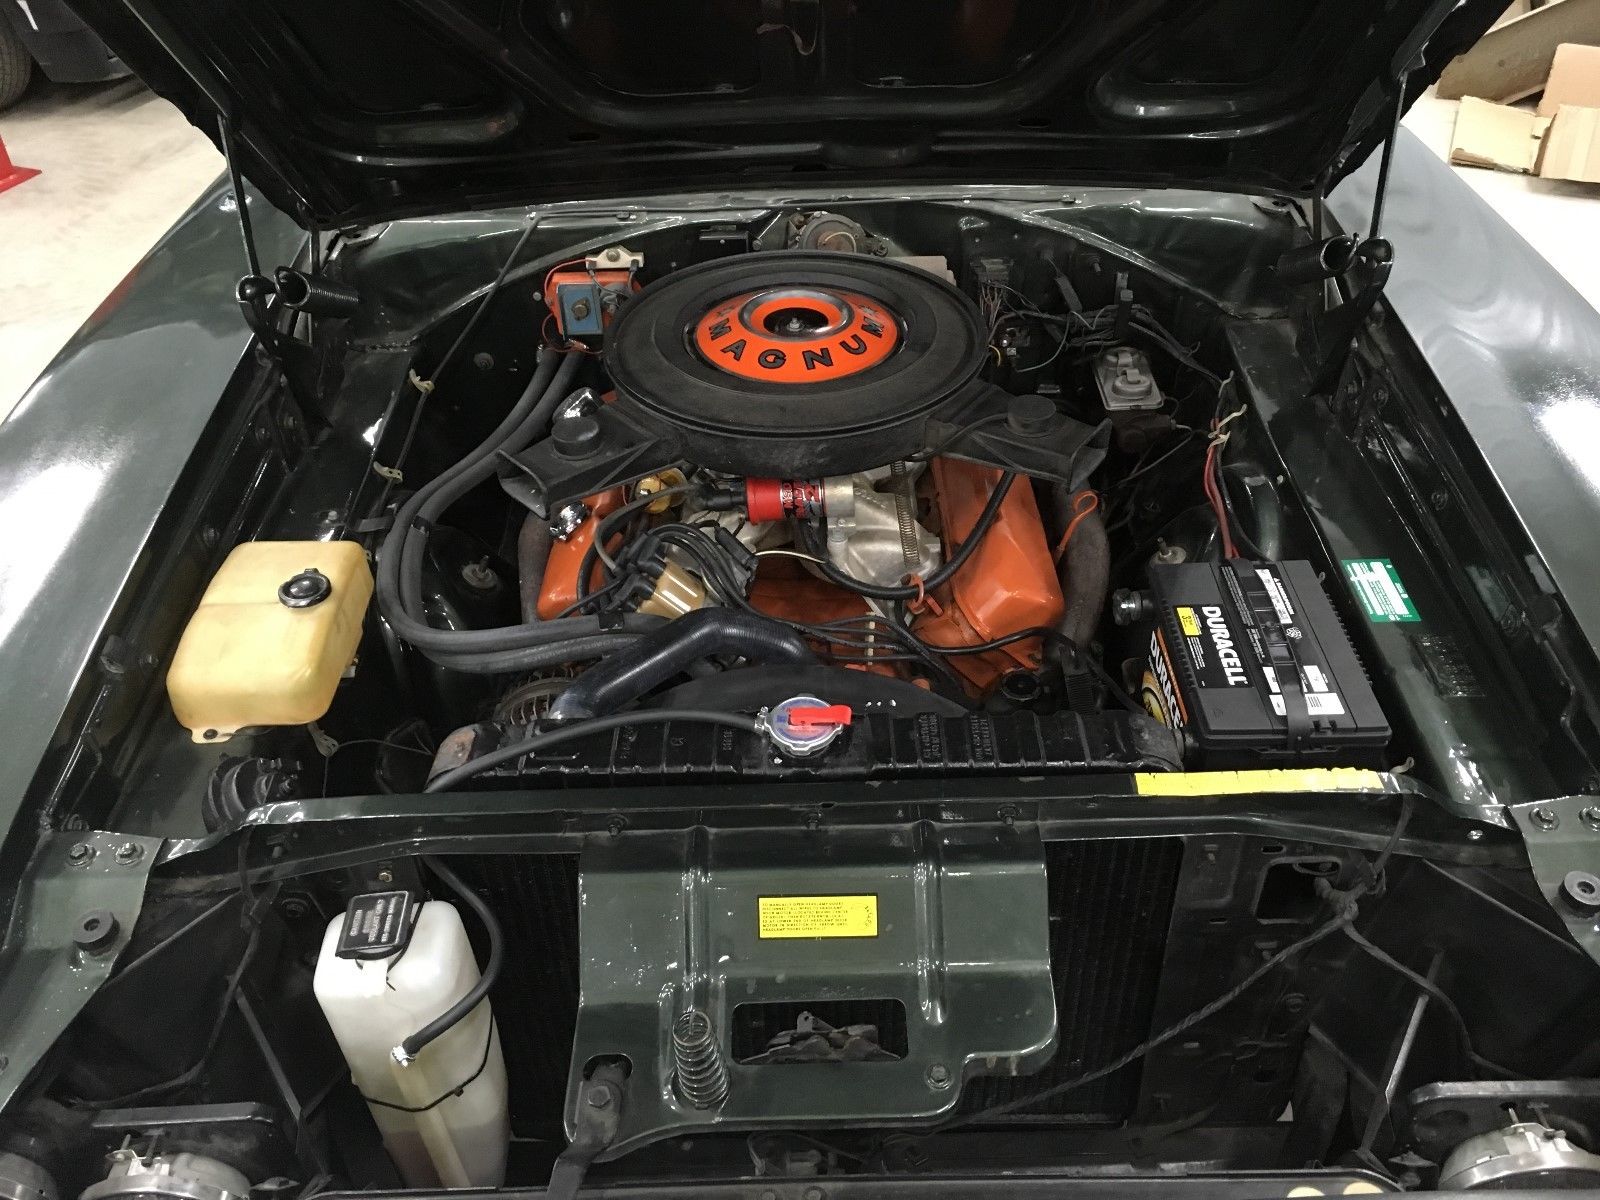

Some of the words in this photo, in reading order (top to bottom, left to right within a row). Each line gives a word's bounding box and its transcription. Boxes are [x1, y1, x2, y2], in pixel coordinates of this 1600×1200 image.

[708, 317, 885, 371] MAGNUM
[1150, 630, 1184, 730] DURACE
[1201, 606, 1248, 686] DURACELL
